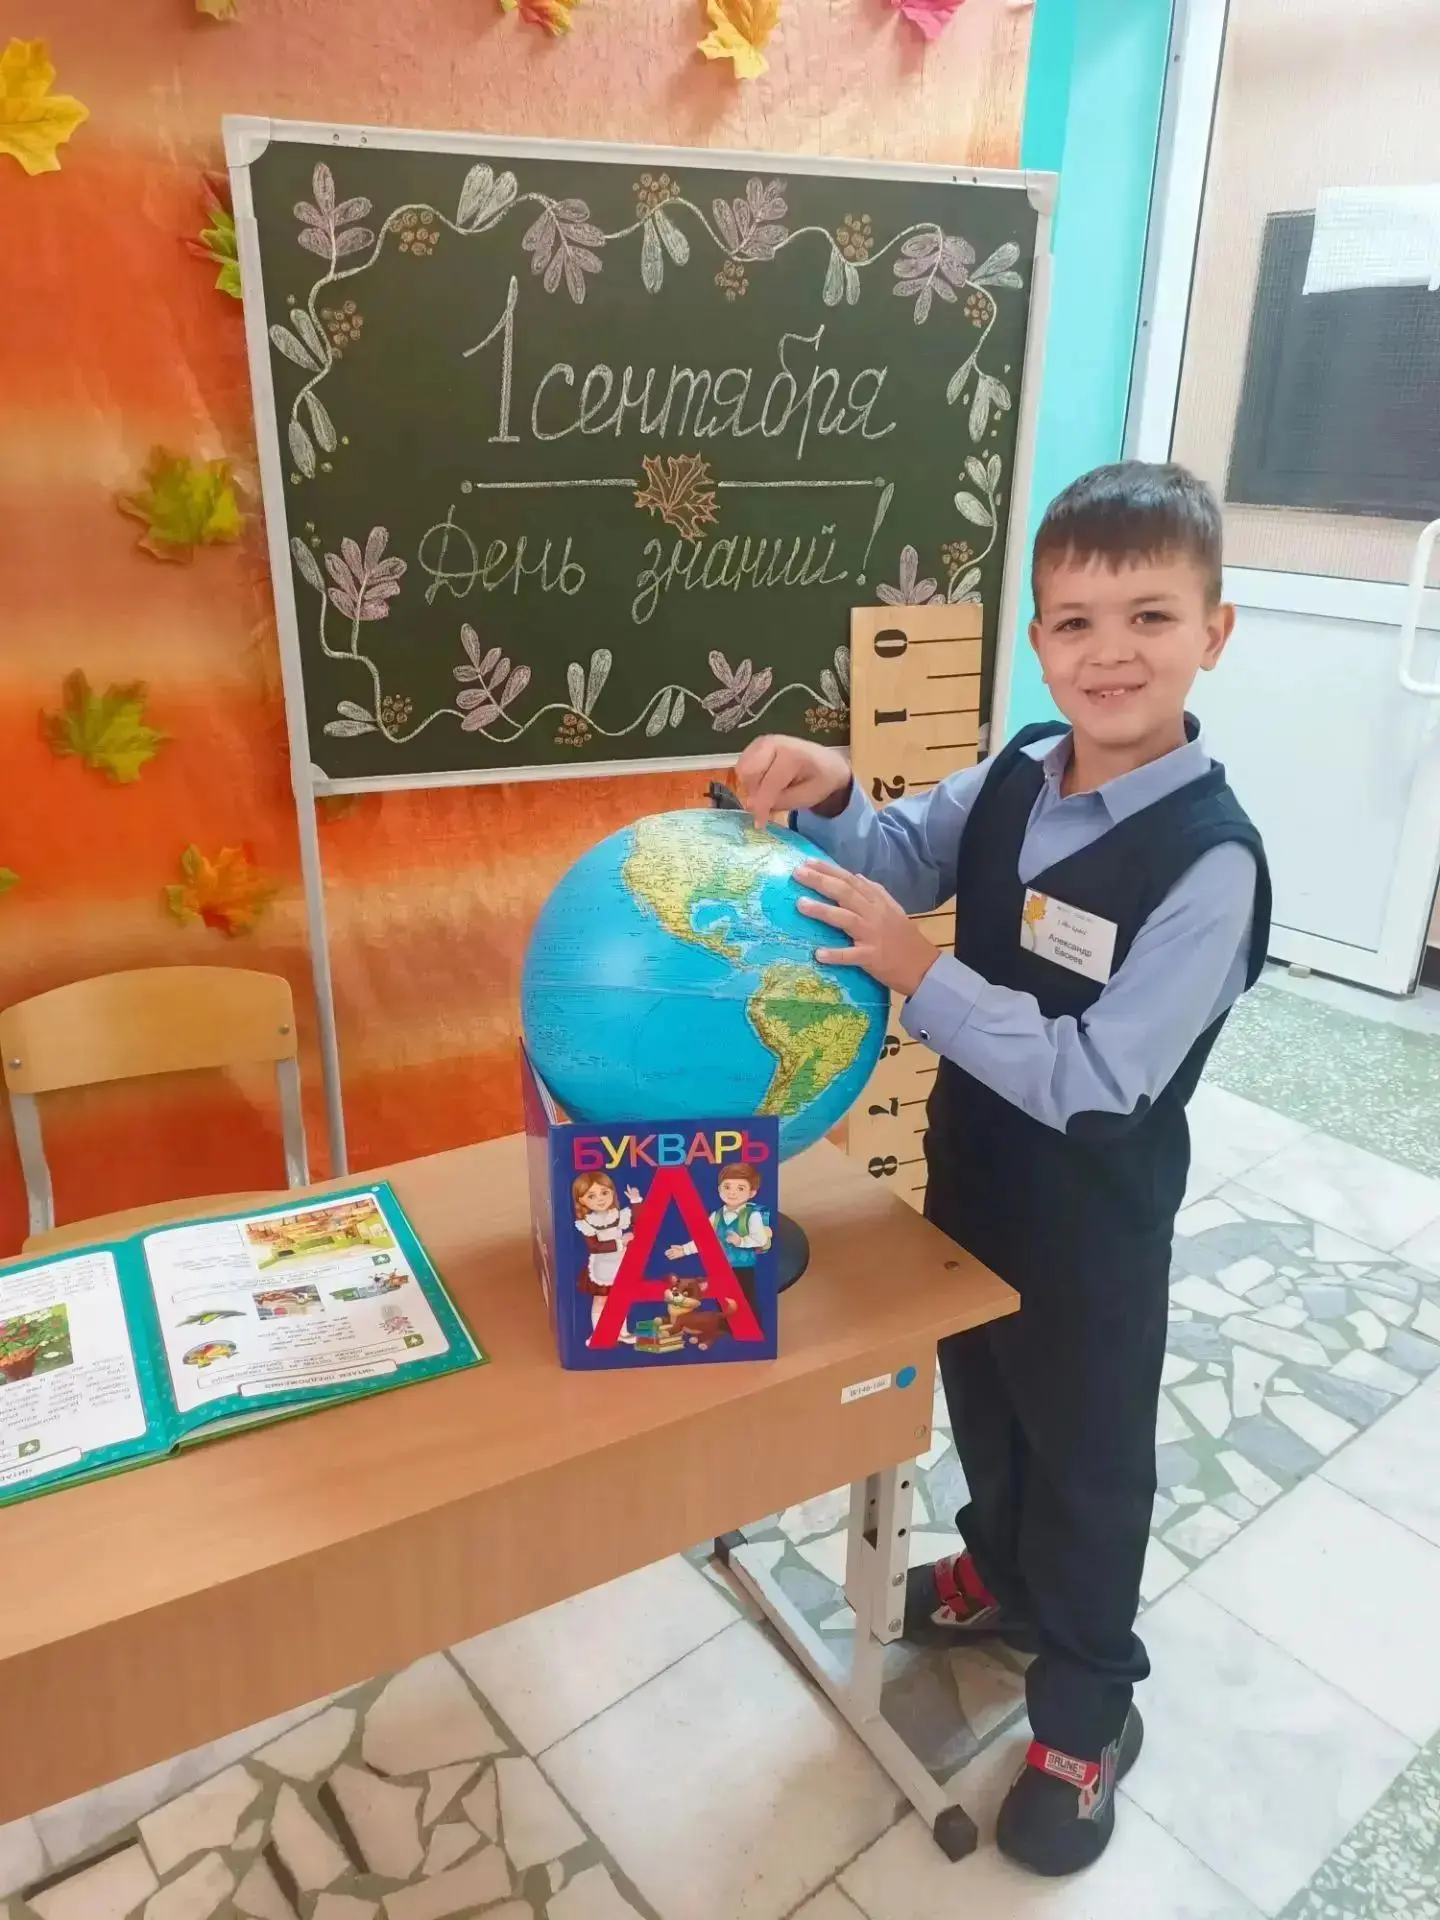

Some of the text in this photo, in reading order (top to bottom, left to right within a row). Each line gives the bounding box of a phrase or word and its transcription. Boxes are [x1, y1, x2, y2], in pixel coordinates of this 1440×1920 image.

[462, 275, 897, 460] 1 сентября
[418, 504, 586, 606] День
[874, 629, 908, 658] 0
[874, 708, 907, 726] 1
[872, 775, 905, 801] 2
[1048, 933, 1093, 958] Александр
[868, 1097, 899, 1117] 7
[573, 1129, 770, 1171] БУКВАРЬ
[868, 1155, 898, 1179] 8
[586, 1164, 766, 1349] А
